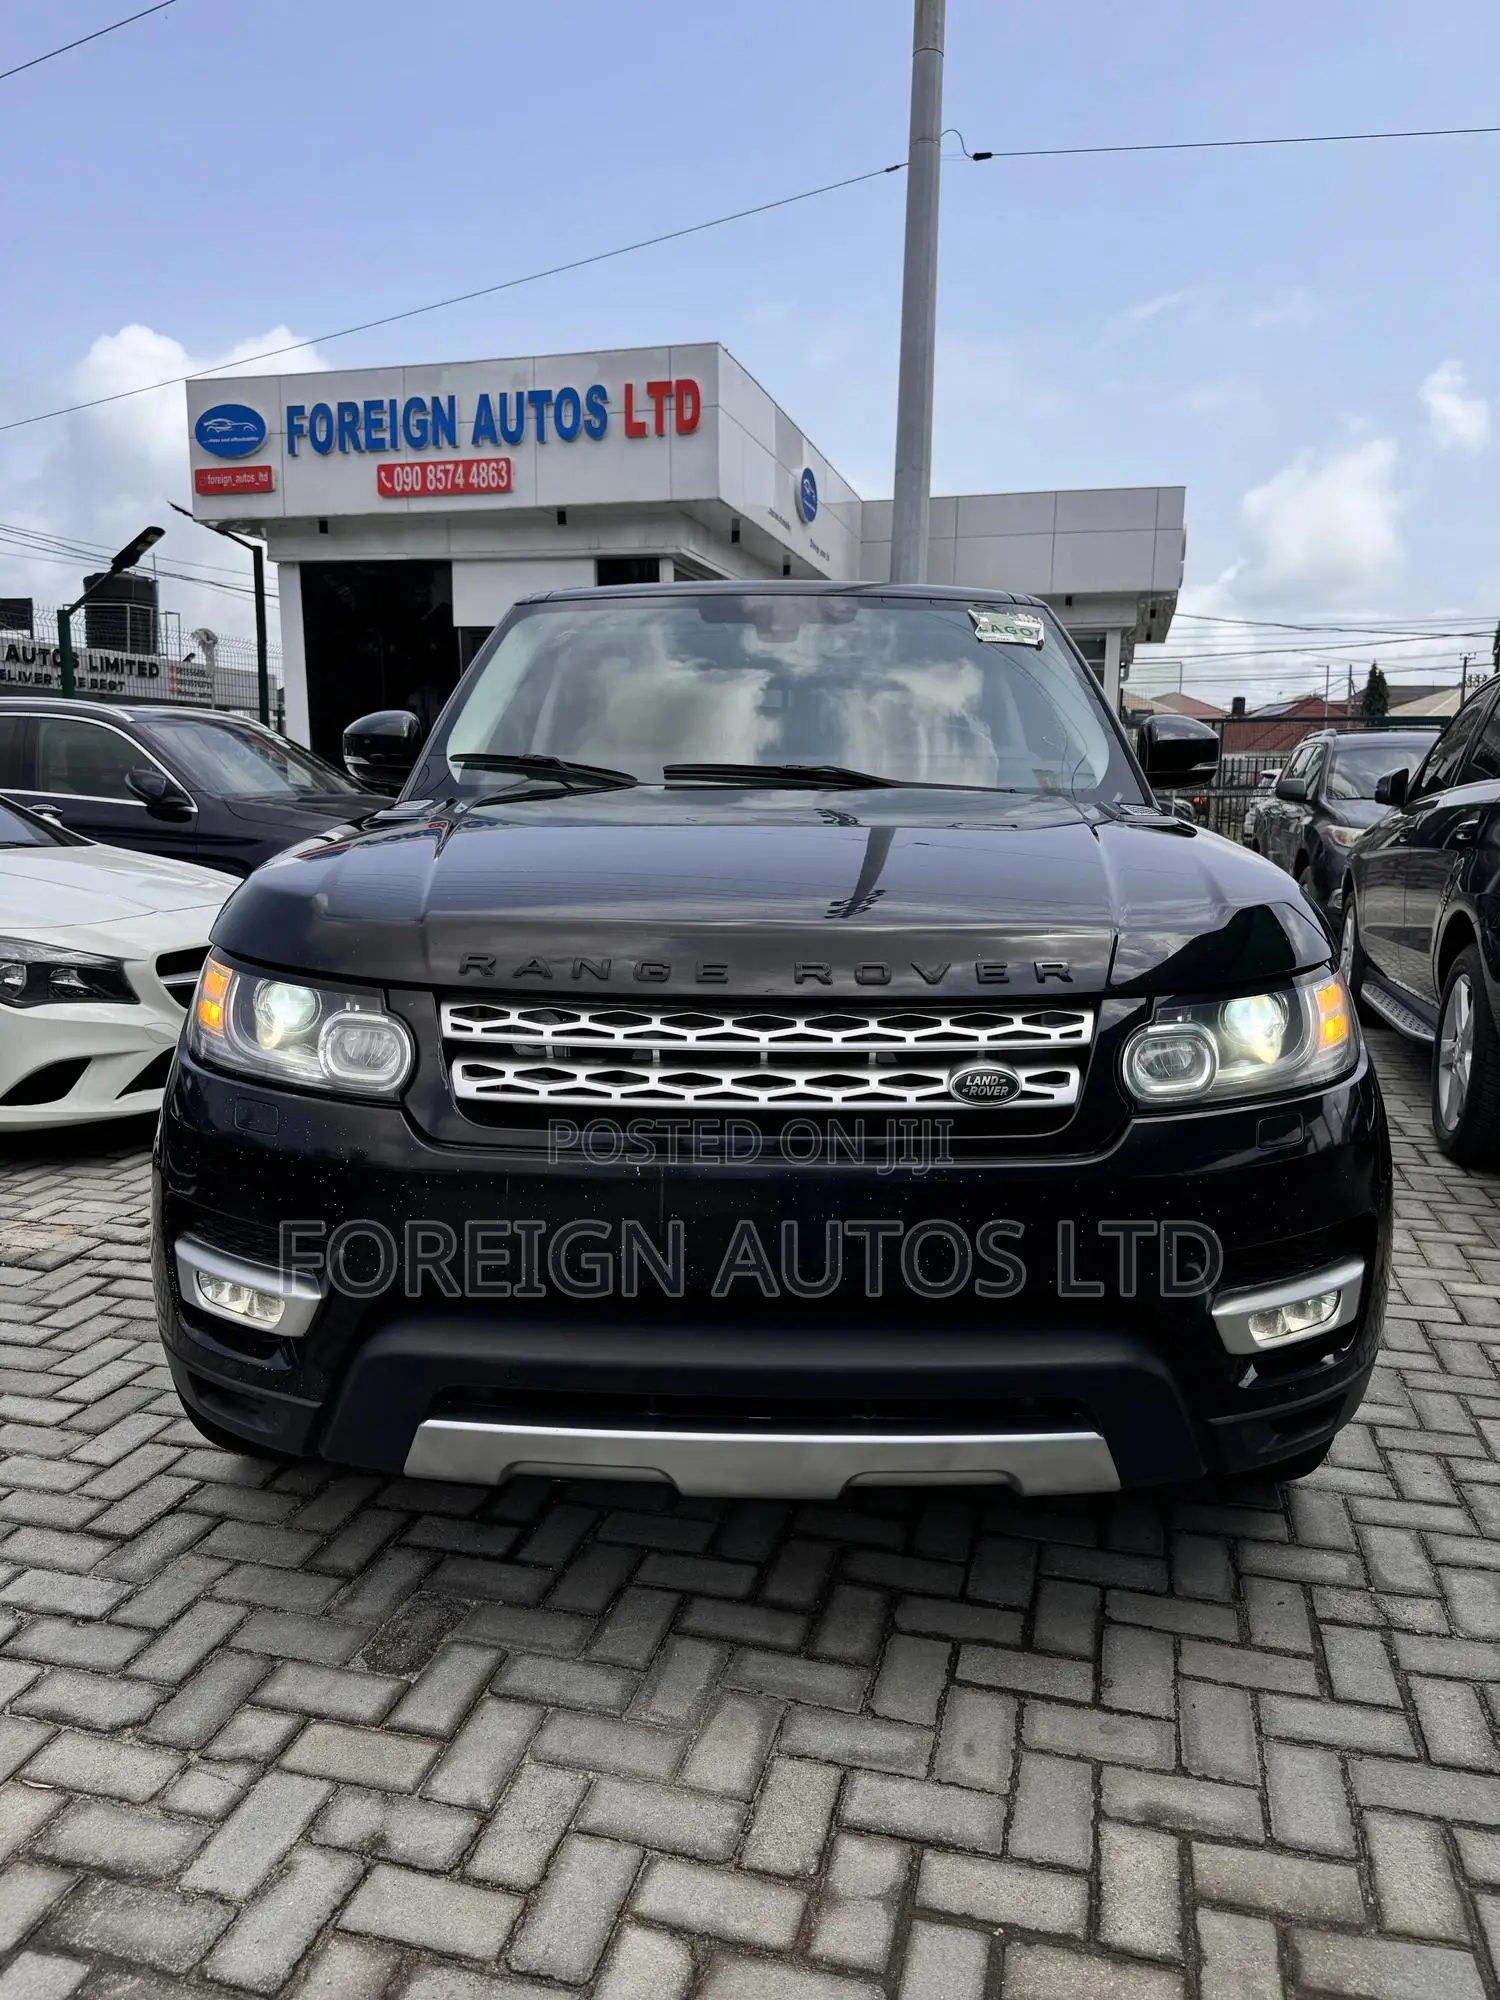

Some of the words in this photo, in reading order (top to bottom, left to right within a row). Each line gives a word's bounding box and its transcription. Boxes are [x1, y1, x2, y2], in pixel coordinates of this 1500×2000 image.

[286, 395, 458, 455] FOREIGN
[471, 384, 608, 447] AUTOS
[624, 378, 701, 438] LTD
[394, 466, 422, 492] 090
[426, 463, 465, 490] 8574
[469, 460, 508, 488] 4863
[88, 654, 159, 678] LIMITED
[458, 953, 729, 984] RANGE
[793, 961, 1075, 985] ROVER
[966, 1076, 999, 1085] LAND
[968, 1086, 1009, 1096] ROVER
